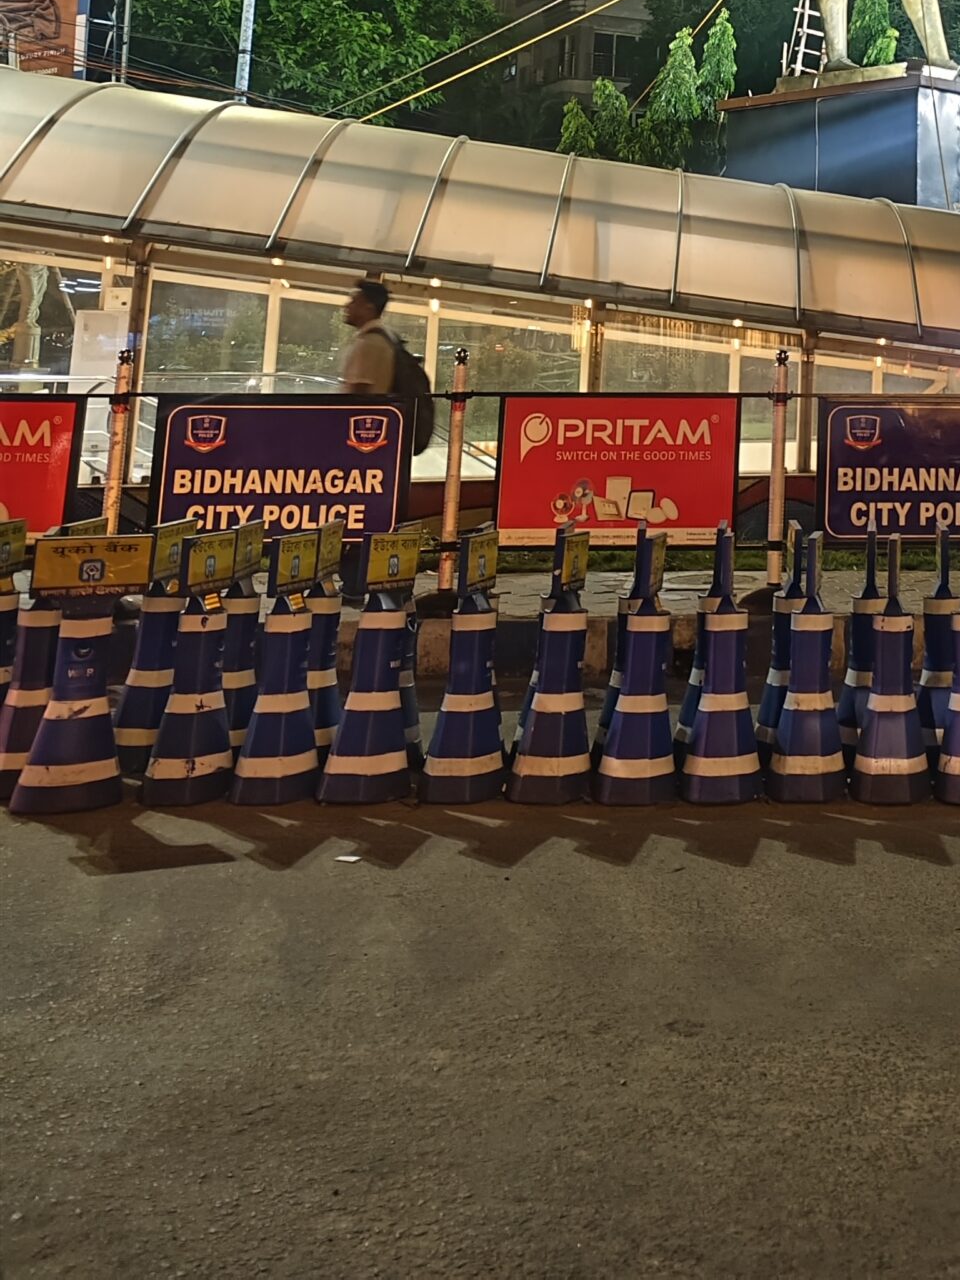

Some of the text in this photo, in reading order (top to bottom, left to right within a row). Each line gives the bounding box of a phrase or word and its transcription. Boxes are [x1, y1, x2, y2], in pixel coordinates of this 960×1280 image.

[557, 419, 711, 445] PRITAM
[15, 453, 50, 463] TIMES
[556, 450, 711, 461] SWITCH ON THE GOOD TIMES
[173, 469, 383, 494] BIDHANNAGAR
[186, 505, 365, 529] CITY POLICE
[851, 502, 911, 526] CITY
[50, 541, 141, 559] यूको बैंक
